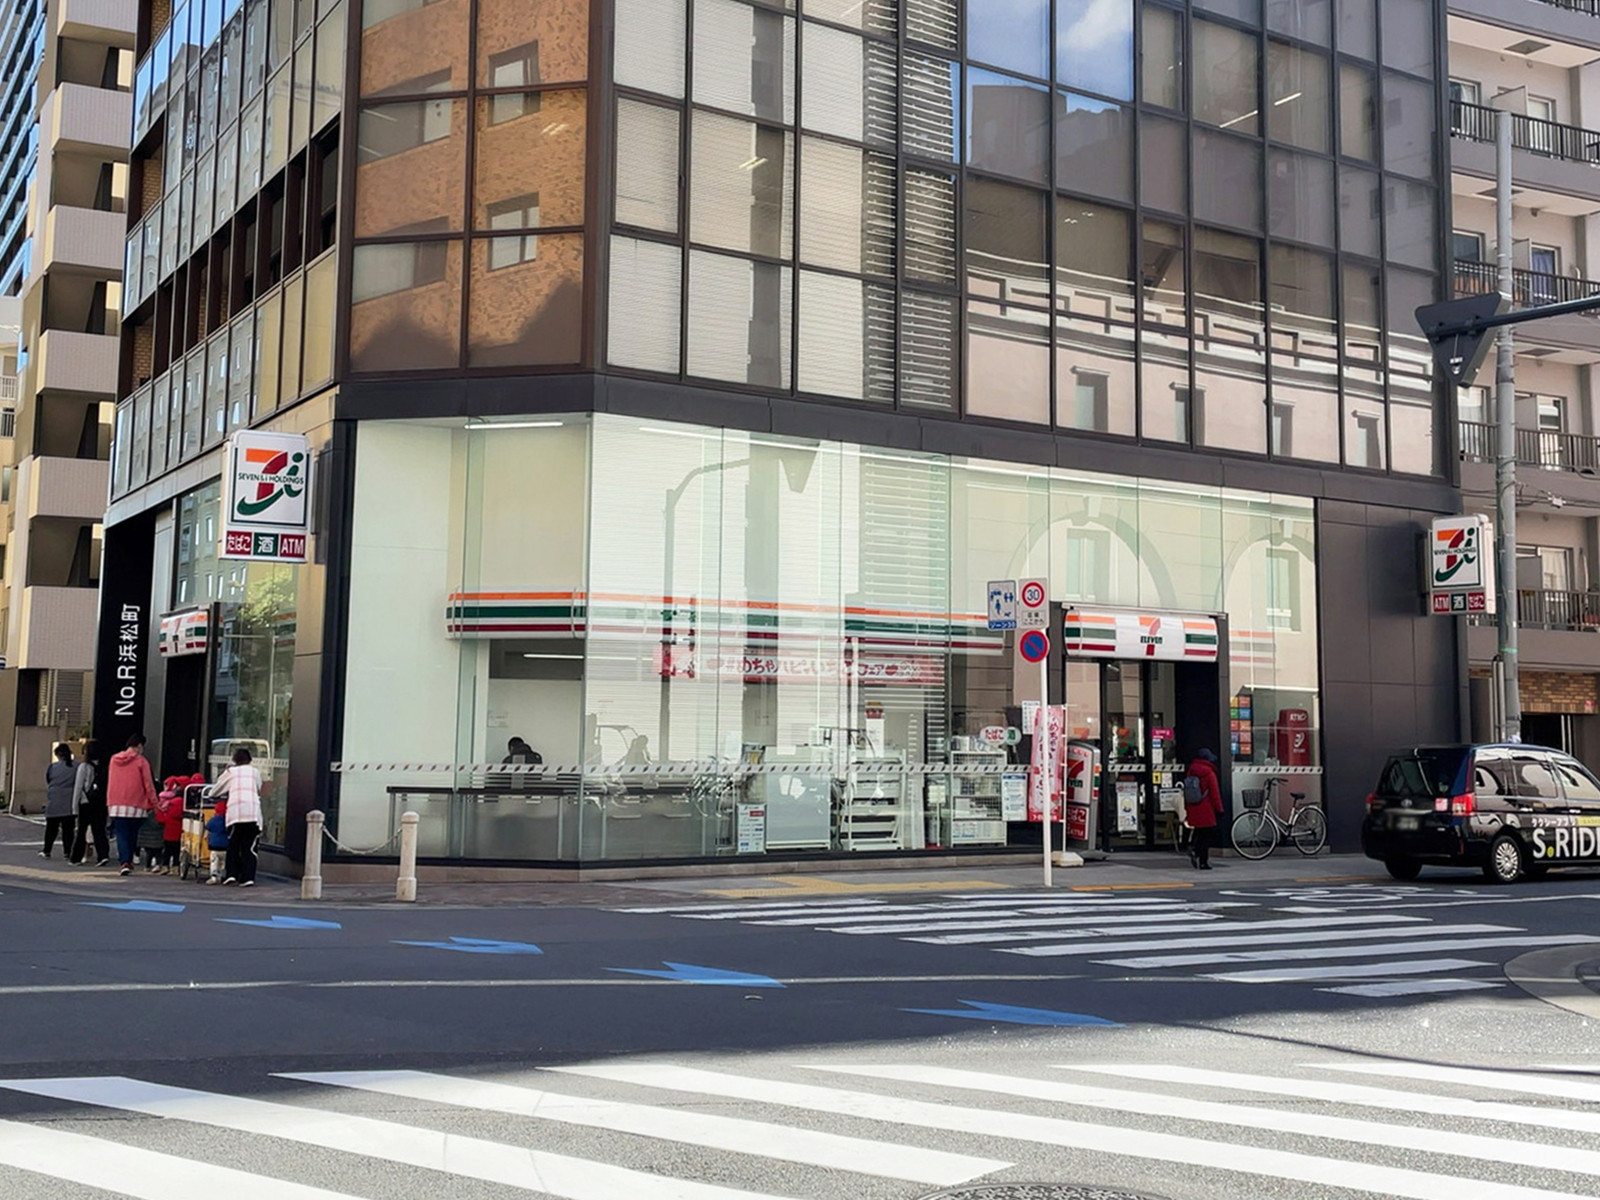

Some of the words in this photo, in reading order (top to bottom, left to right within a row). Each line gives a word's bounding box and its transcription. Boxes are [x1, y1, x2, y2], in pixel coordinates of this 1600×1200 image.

[268, 475, 304, 485] HOLDINGS
[227, 534, 251, 552] たばこ
[257, 536, 275, 553] 酒
[281, 538, 304, 554] ATM
[1027, 589, 1040, 601] 30
[1434, 597, 1449, 609] ATM
[114, 603, 140, 716] No.R浜松町
[984, 729, 1005, 741] たばこ
